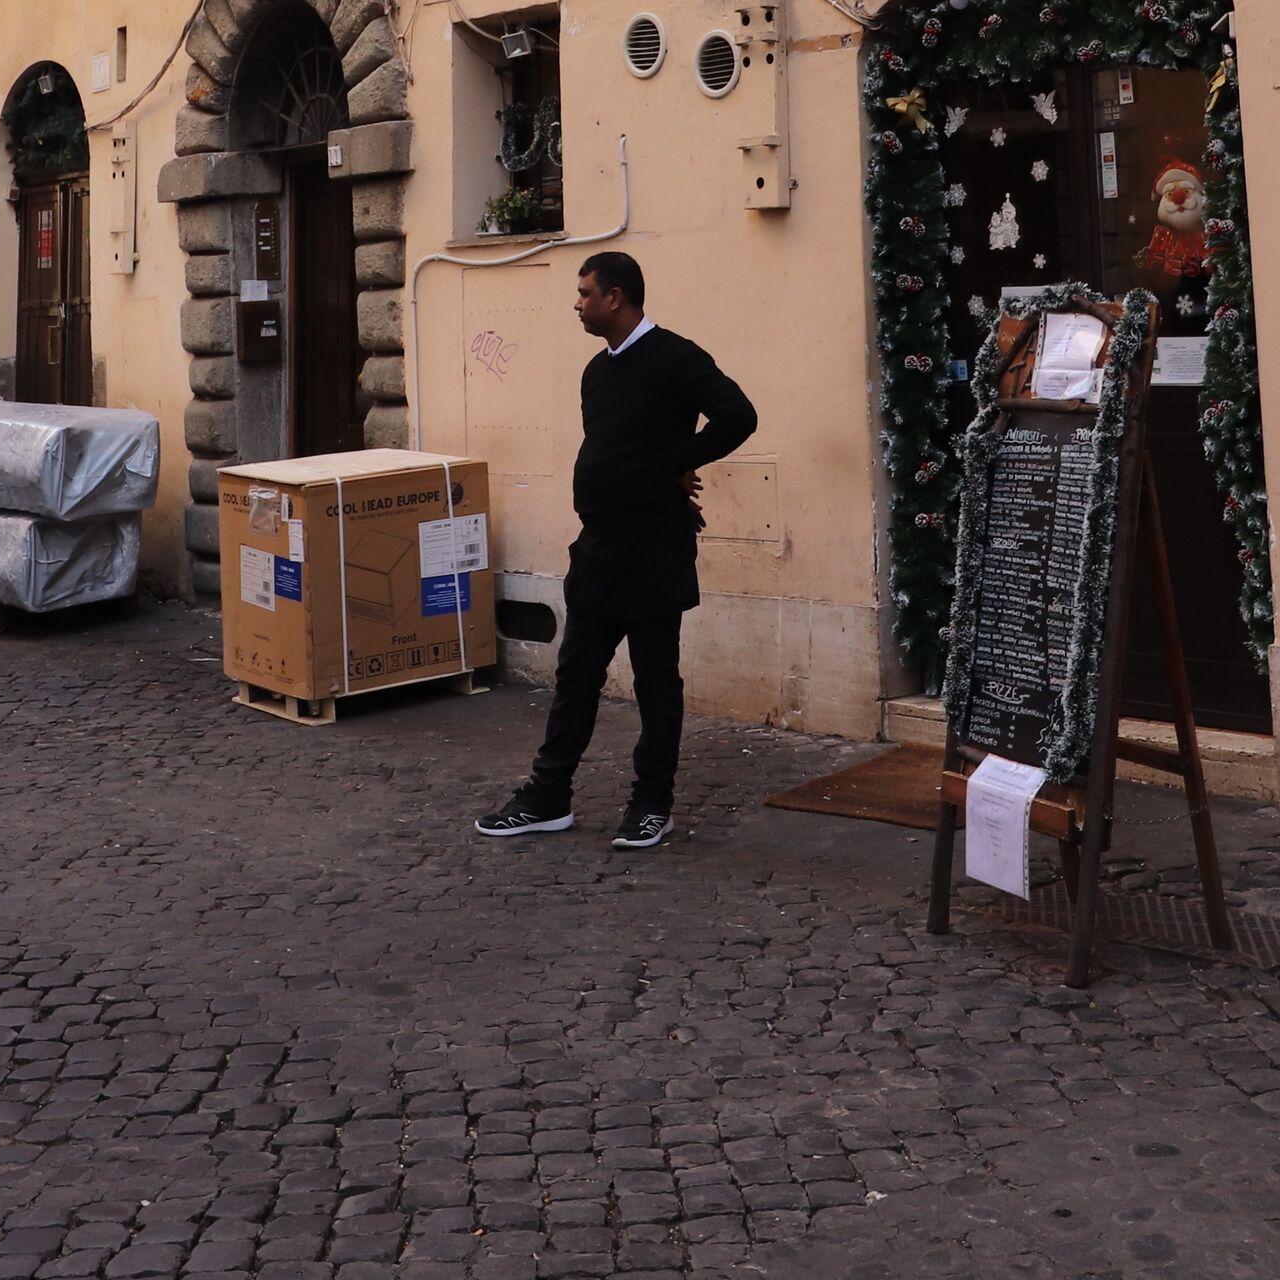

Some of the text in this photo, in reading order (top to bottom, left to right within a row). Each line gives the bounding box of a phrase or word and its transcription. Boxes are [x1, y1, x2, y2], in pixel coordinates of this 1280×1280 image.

[326, 503, 357, 517] COOL
[397, 490, 440, 508] EUROPE
[392, 633, 417, 646] Front
[986, 681, 1019, 700] PIZZE
